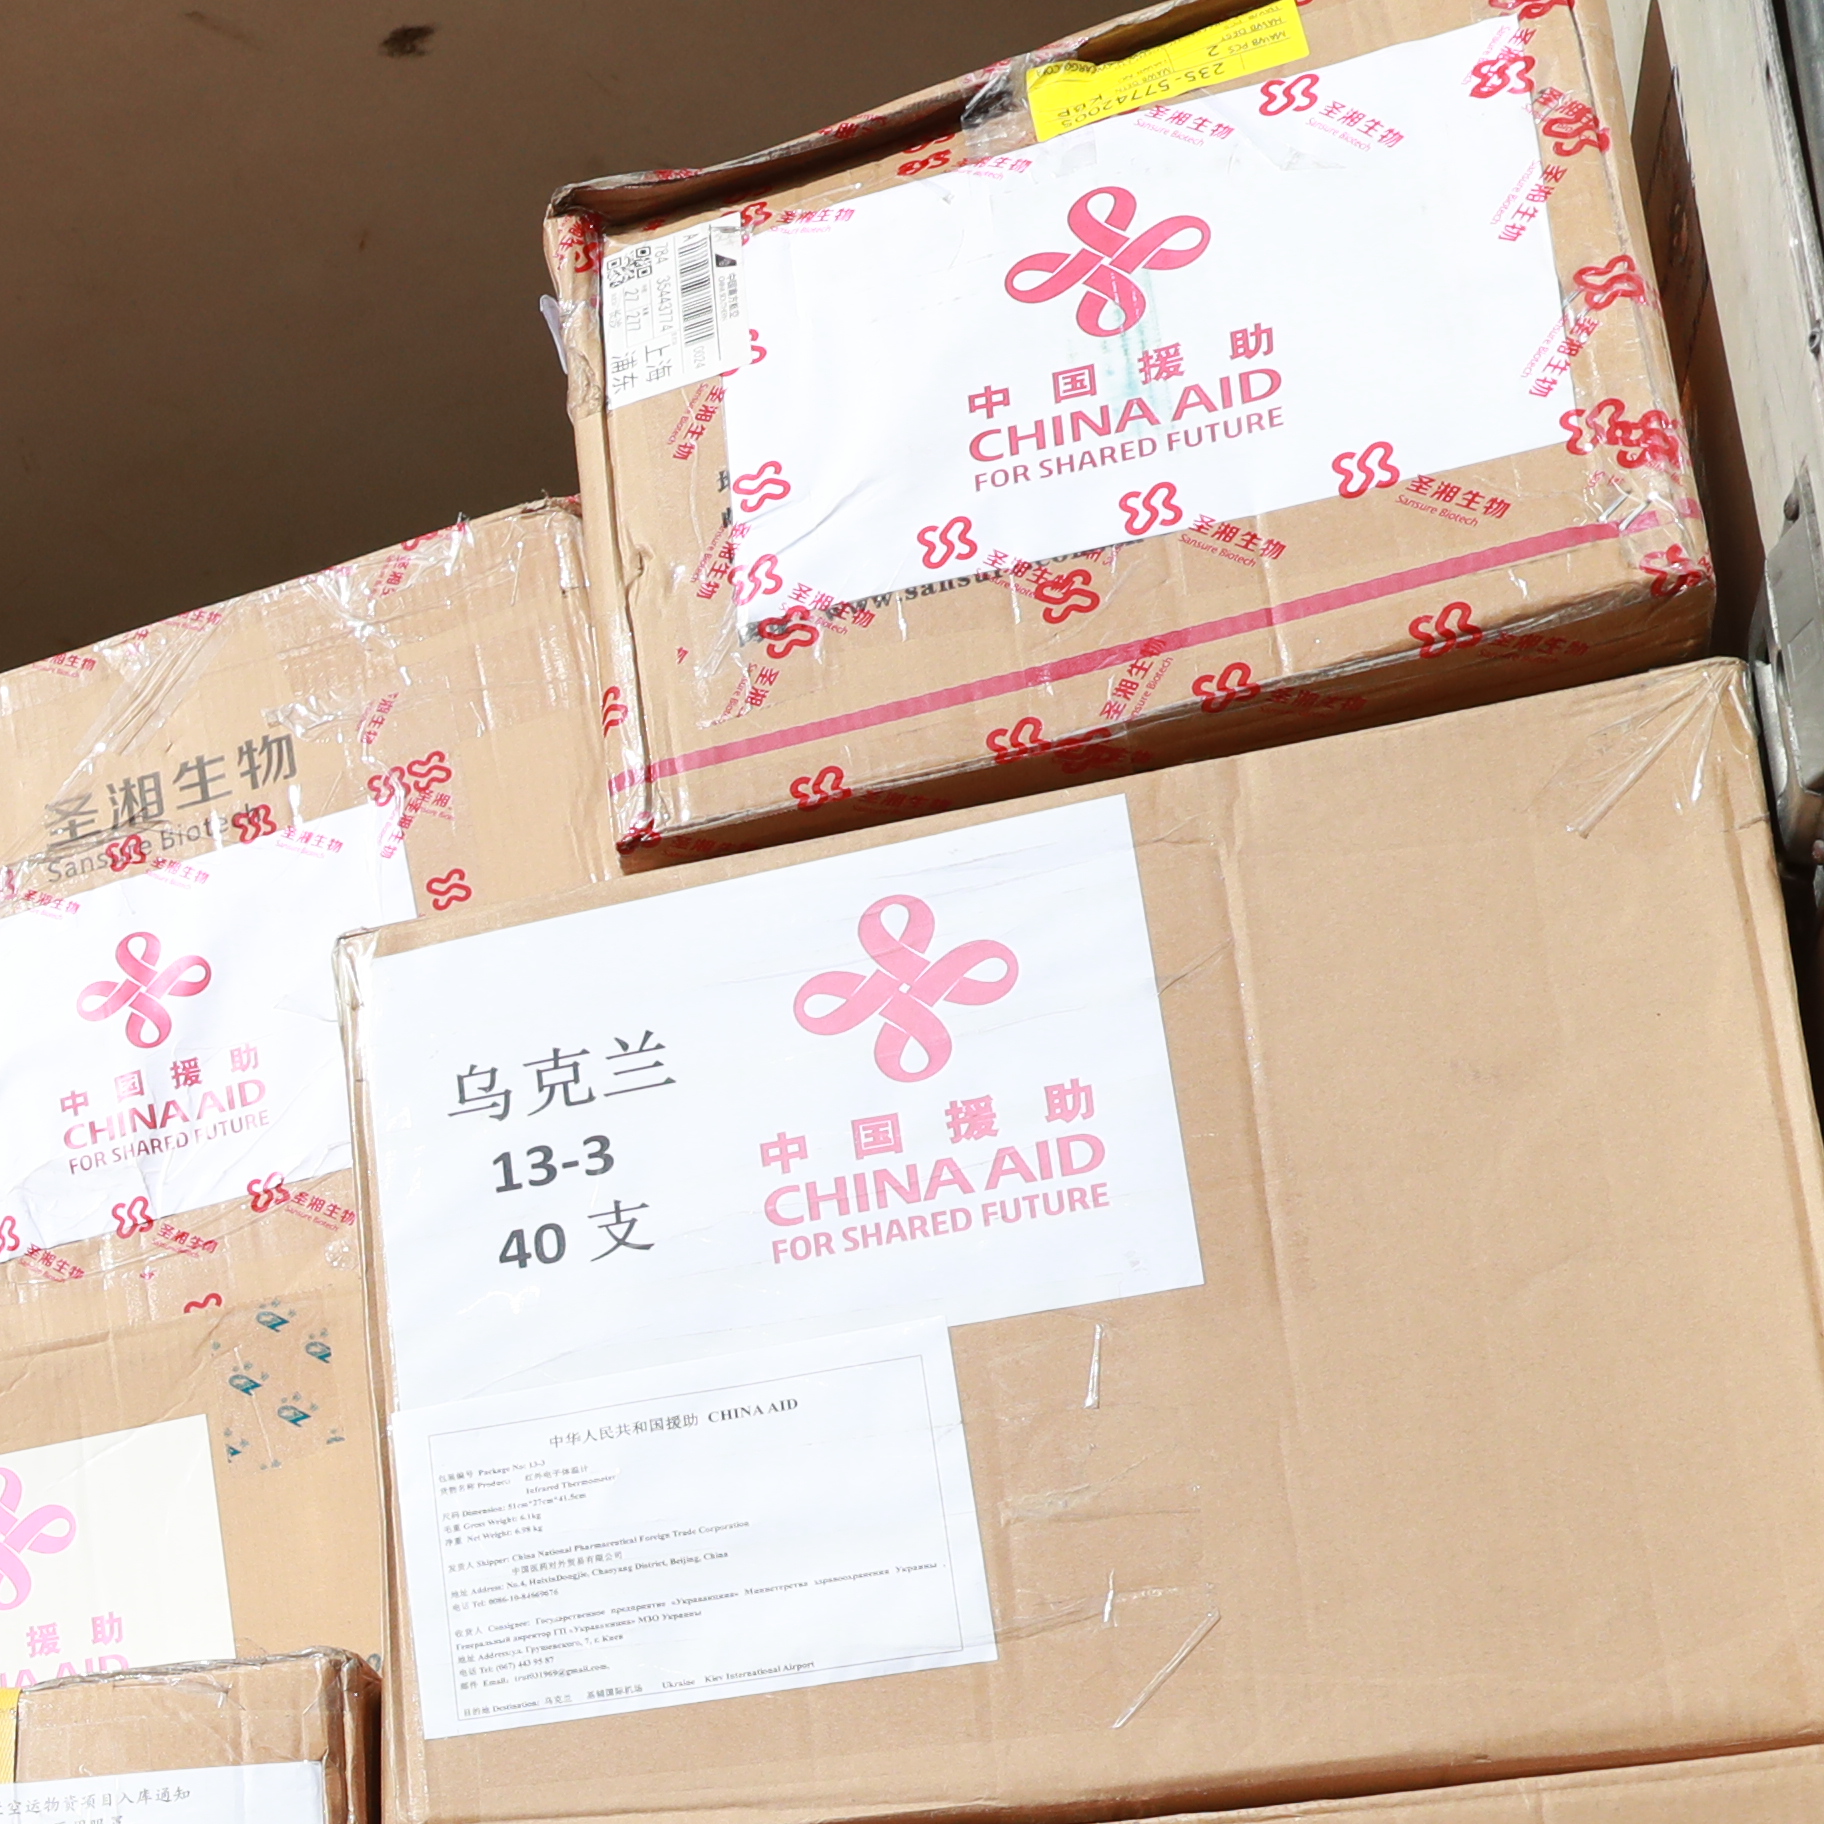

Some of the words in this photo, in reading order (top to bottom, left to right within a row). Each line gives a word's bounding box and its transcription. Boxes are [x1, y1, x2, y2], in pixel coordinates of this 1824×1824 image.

[1142, 103, 1235, 141] 圣湘生物
[1318, 101, 1404, 148] 圣湘生物
[1497, 164, 1569, 242] 圣湘生物
[654, 242, 669, 265] 784
[656, 275, 674, 334] 35443774
[643, 344, 673, 384] 上海
[968, 322, 1274, 420] 中国援助
[672, 384, 728, 461] 圣湘生物
[969, 397, 1161, 463] CHINA
[1170, 367, 1282, 422] AID
[974, 465, 1031, 492] FOR
[1039, 437, 1158, 479] SHARED
[1167, 406, 1284, 452] FUTURE
[1394, 493, 1440, 514] Sansure
[1440, 507, 1480, 528] Biotech
[1405, 474, 1511, 520] 圣湘生物
[1190, 514, 1287, 561] 圣湘生物
[44, 732, 298, 849] 圣湘生物
[59, 1041, 261, 1118] 中国援助
[446, 1029, 677, 1123] 乌克兰
[62, 1097, 189, 1151] CHINA
[196, 1078, 266, 1123] AID
[69, 1153, 108, 1176] FOR
[112, 1130, 189, 1164] SHARED
[195, 1109, 270, 1146] FUTURE
[758, 1078, 1096, 1177] 中国援助
[490, 1133, 617, 1195] 13-3
[762, 1158, 976, 1228] CHINA
[984, 1132, 1107, 1191] AID
[497, 1223, 568, 1270] 40
[587, 1198, 656, 1262] 支
[770, 1228, 836, 1264] FOR
[841, 1206, 974, 1253] SHARED
[980, 1182, 1110, 1226] FUTURE
[549, 1413, 698, 1449] 中华人民共和国援助
[707, 1403, 764, 1425] CHINA
[767, 1398, 799, 1415] AID
